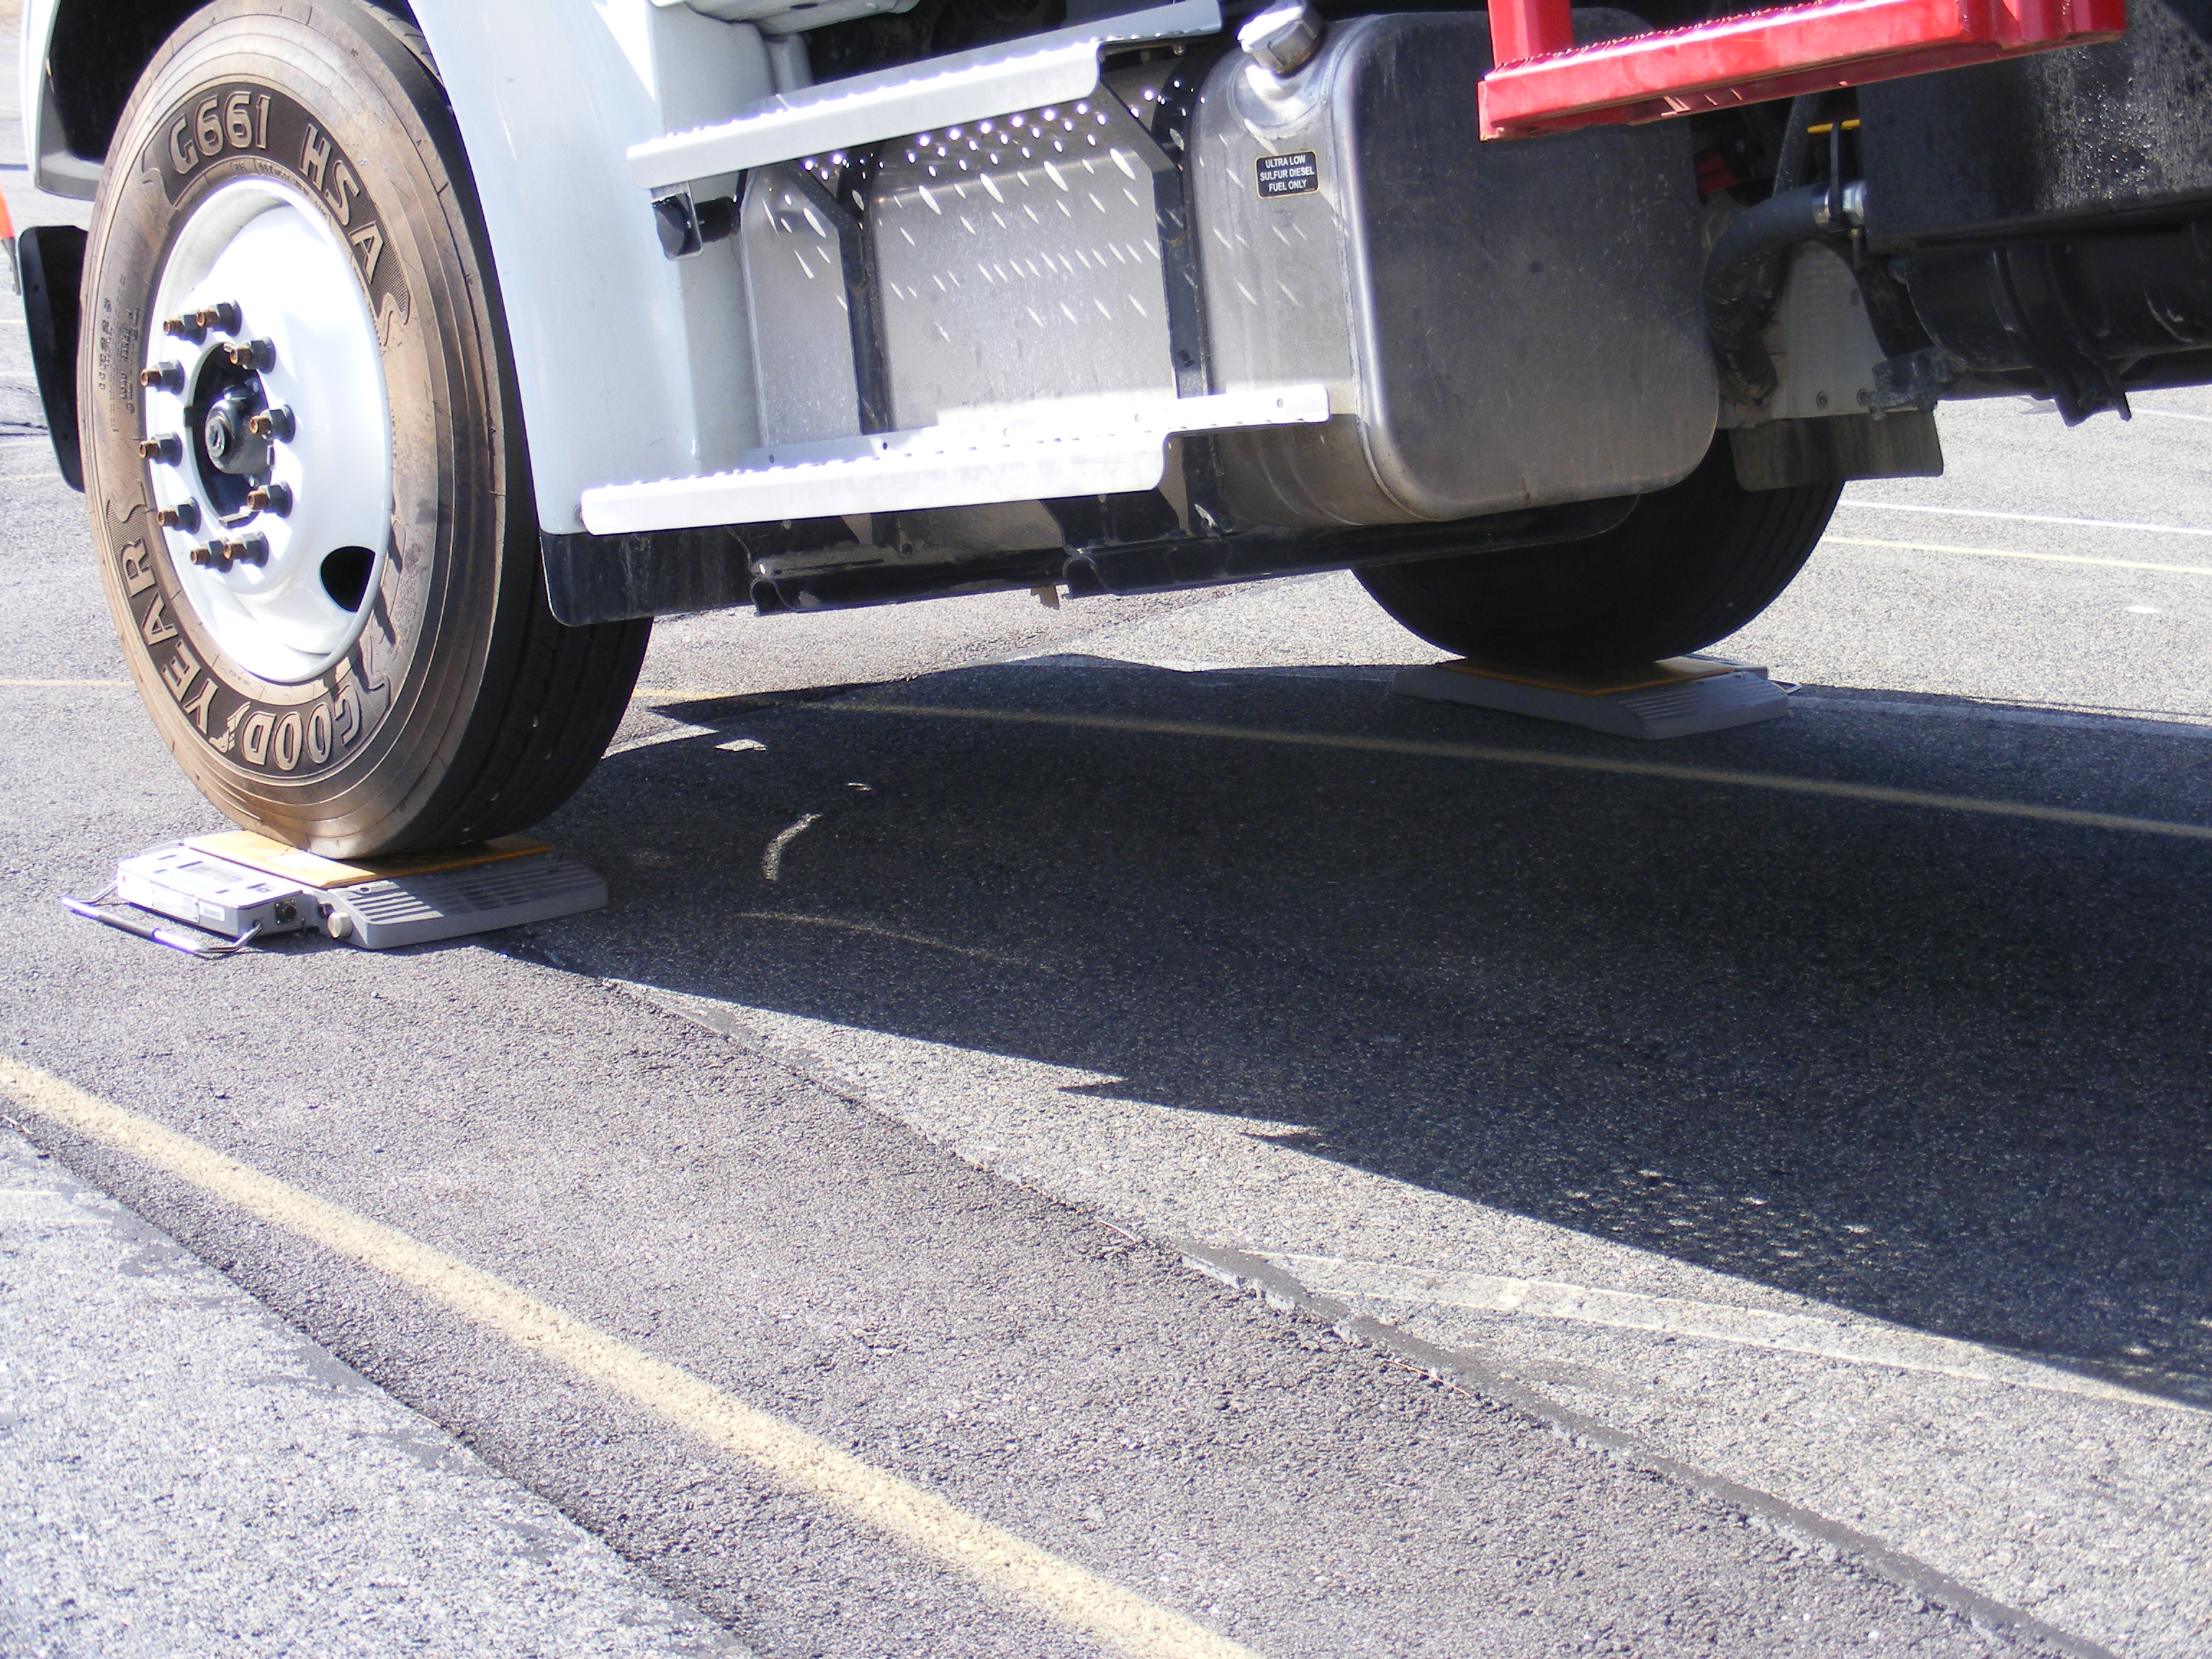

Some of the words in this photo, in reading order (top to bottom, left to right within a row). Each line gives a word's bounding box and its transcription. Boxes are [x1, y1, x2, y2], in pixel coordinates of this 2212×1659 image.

[1265, 158, 1289, 168] ULTRA
[1289, 155, 1306, 166] LOW
[1260, 170, 1288, 181] SULFUR
[1289, 166, 1315, 178] DIESEL
[168, 91, 271, 174] G661
[299, 123, 383, 284] HSA
[1269, 182, 1287, 192] FUEL
[1288, 179, 1307, 190] ONLY
